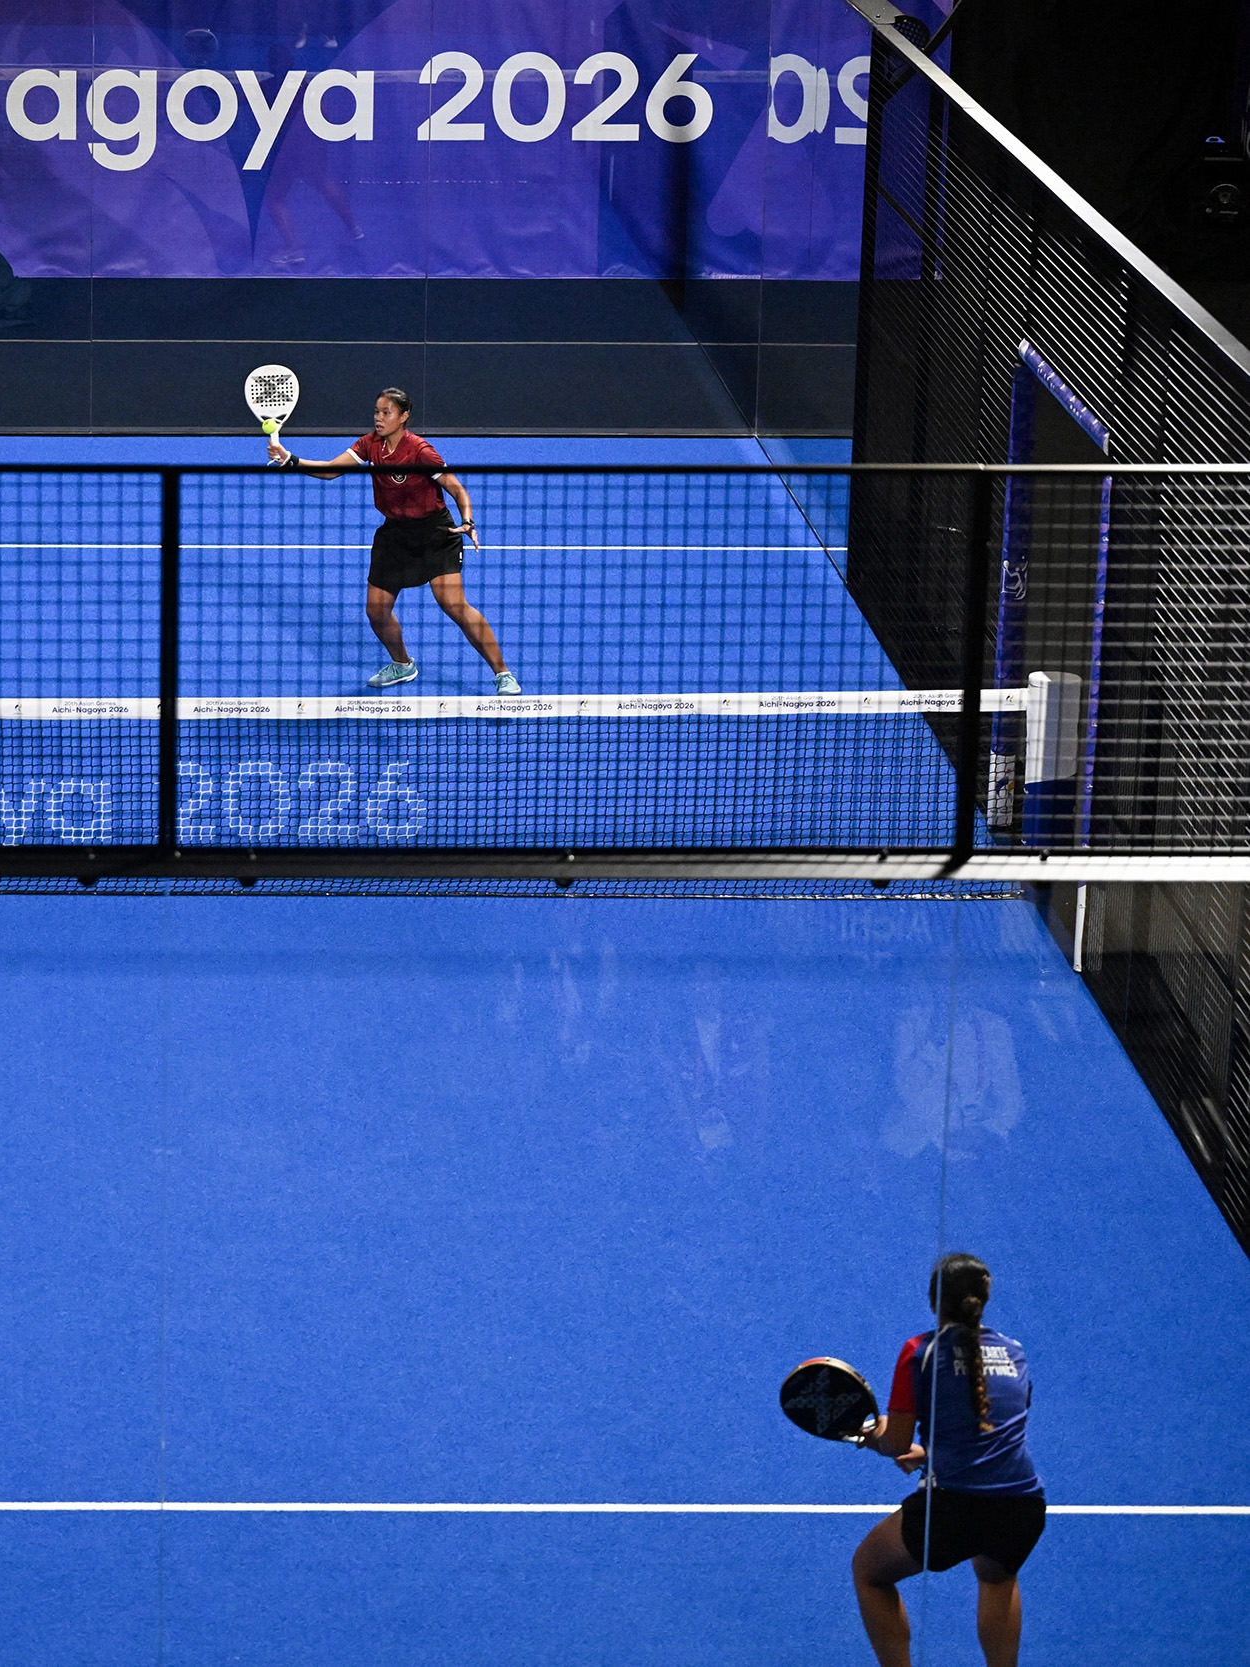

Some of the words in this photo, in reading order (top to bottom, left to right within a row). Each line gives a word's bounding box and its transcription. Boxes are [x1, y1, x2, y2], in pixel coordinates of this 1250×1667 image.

[417, 51, 714, 143] 2026
[617, 702, 672, 711] Aichi-Nagoya
[759, 700, 814, 709] Aichi-Nagoya
[900, 699, 955, 707] Aichi-Nagoya
[52, 706, 107, 715] Aichi-Nagoya
[193, 706, 248, 714] Aichi-Nagoya
[335, 705, 389, 714] Aichi-Nagoya
[476, 703, 531, 713] Aichi-Nagoya
[156, 760, 427, 840] 2026
